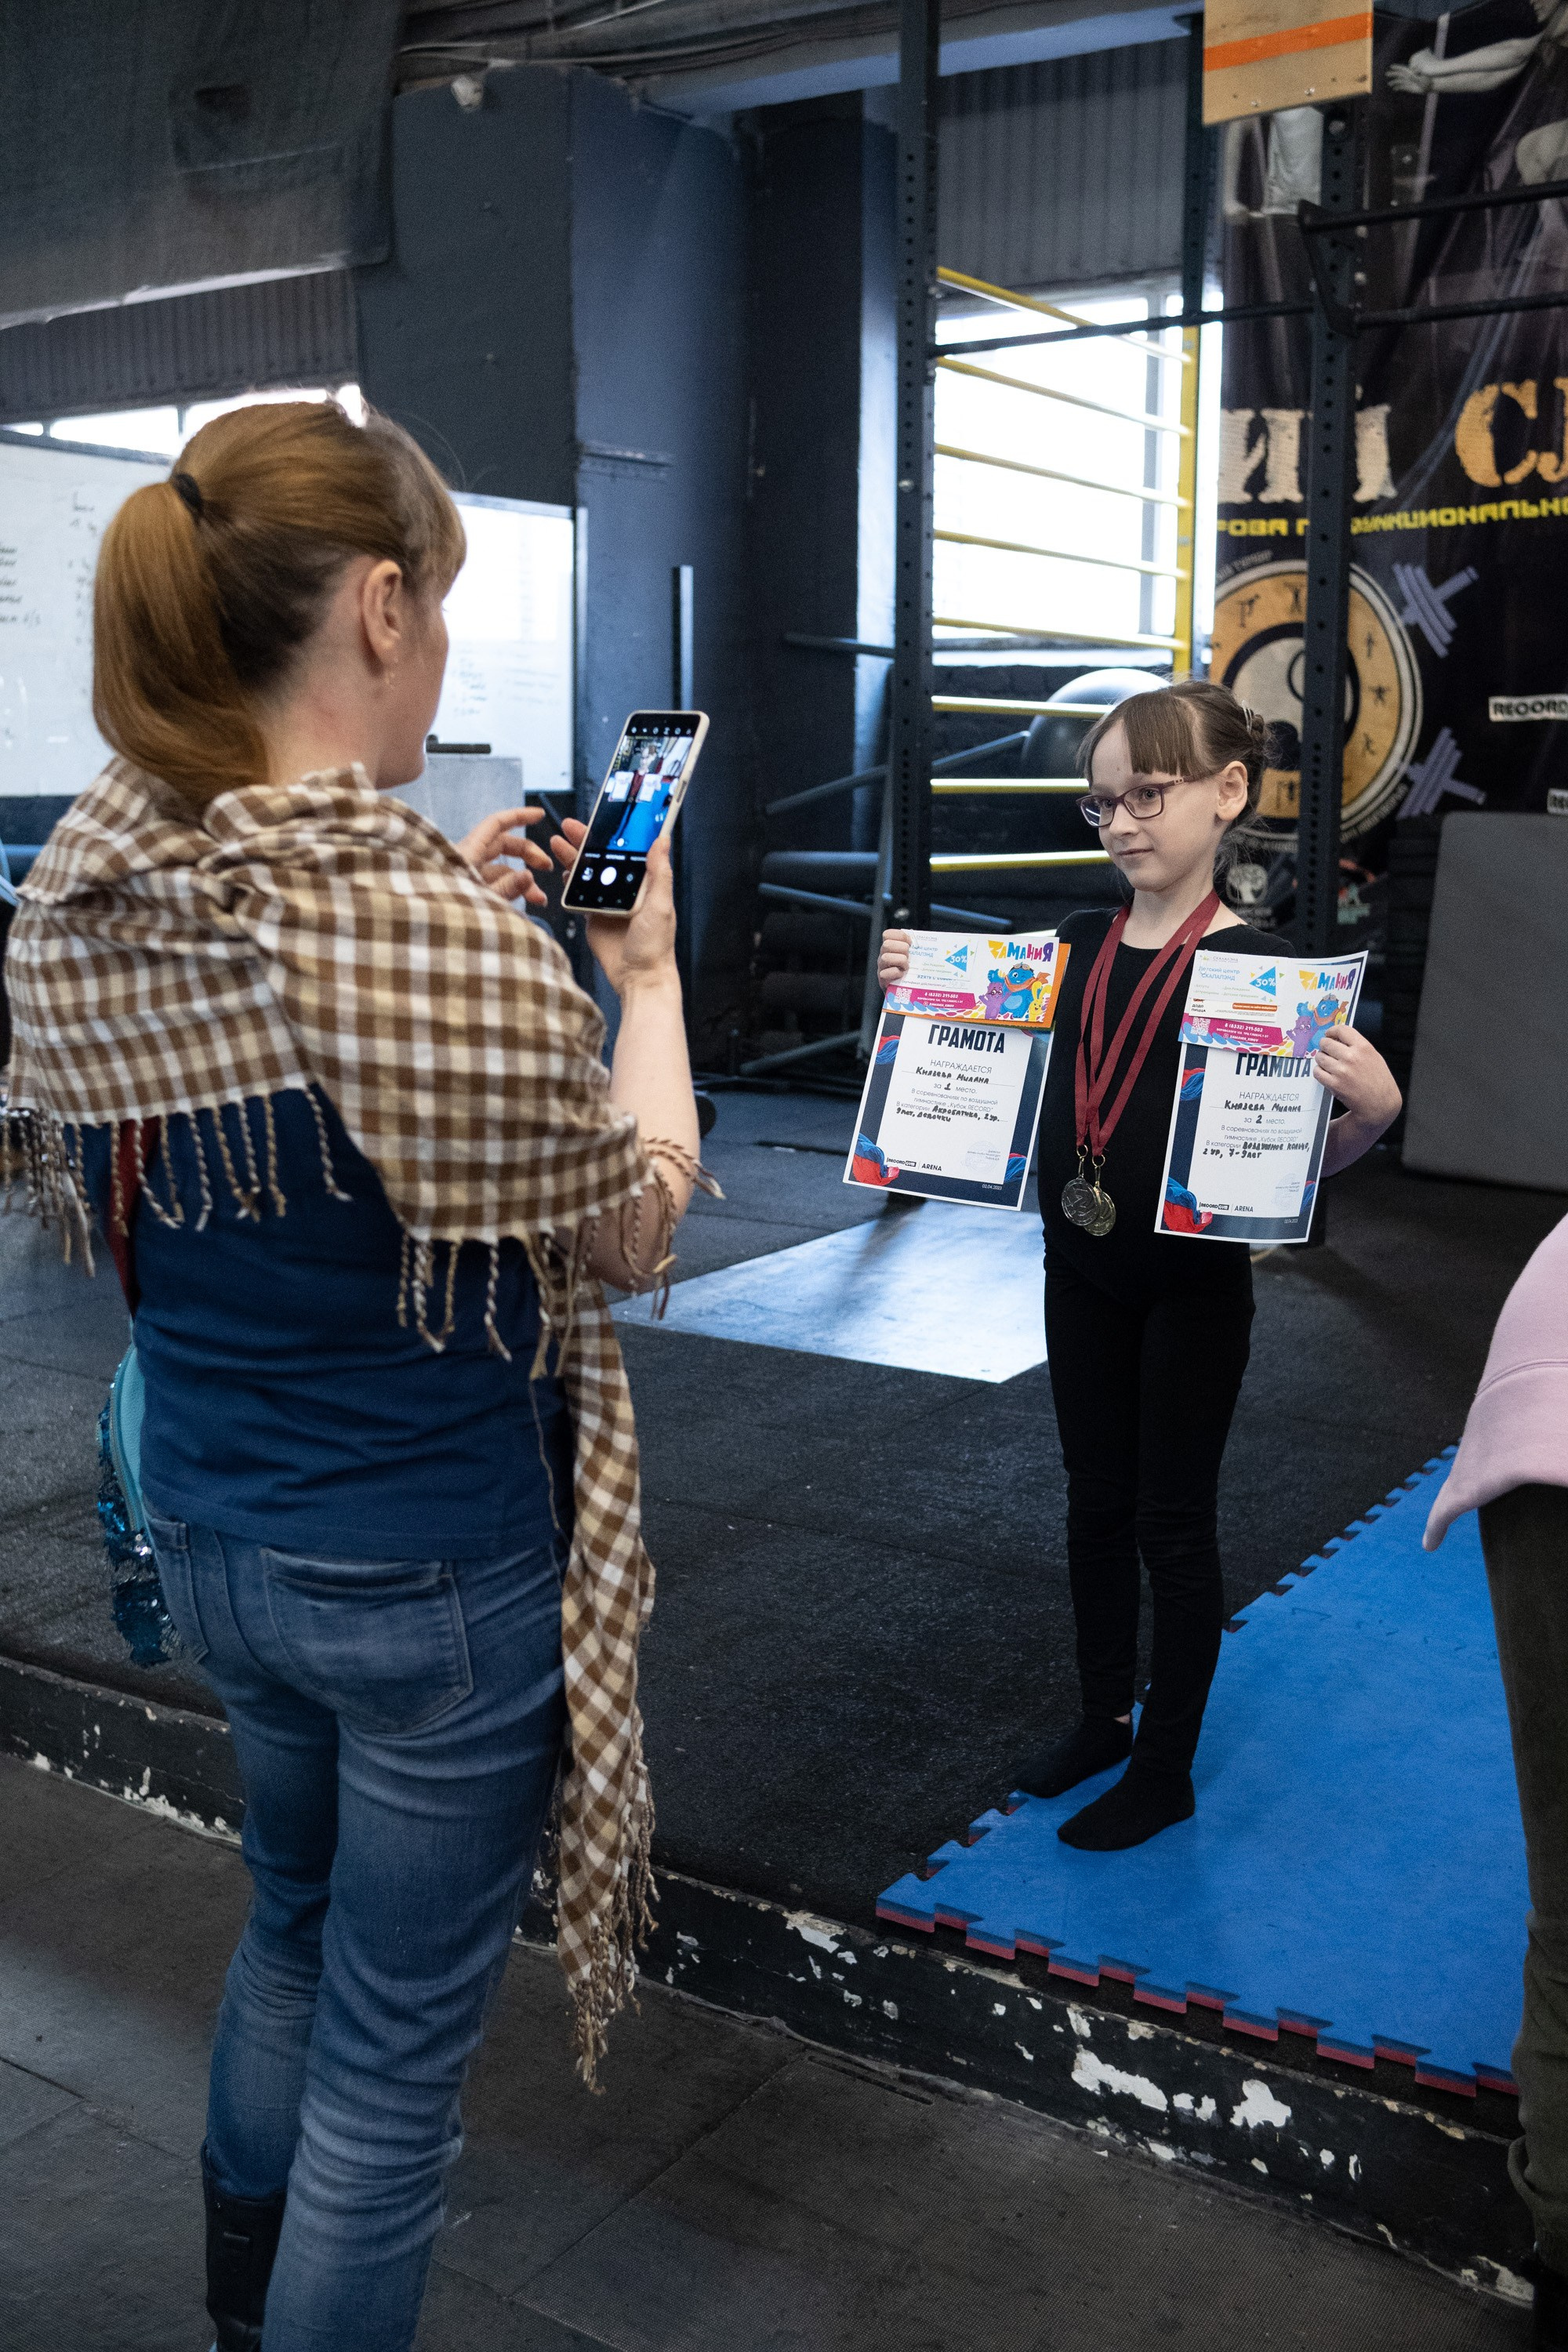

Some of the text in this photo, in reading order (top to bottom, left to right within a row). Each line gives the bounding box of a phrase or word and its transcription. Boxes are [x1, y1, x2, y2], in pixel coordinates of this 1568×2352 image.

[949, 955, 967, 964] 30%
[1256, 978, 1276, 987] 30%
[927, 1024, 1005, 1054] ГРАМОТА
[931, 1059, 993, 1074] НАГРАЖДАЕТСЯ
[1236, 1053, 1311, 1077] ГРАМОТА
[916, 1090, 959, 1101] соревнованиях
[1240, 1091, 1300, 1102] НАГРАЖДАЕТСЯ
[901, 1102, 931, 1112] категории
[914, 1098, 946, 1106] гимнастике
[1256, 1115, 1262, 1124] 2
